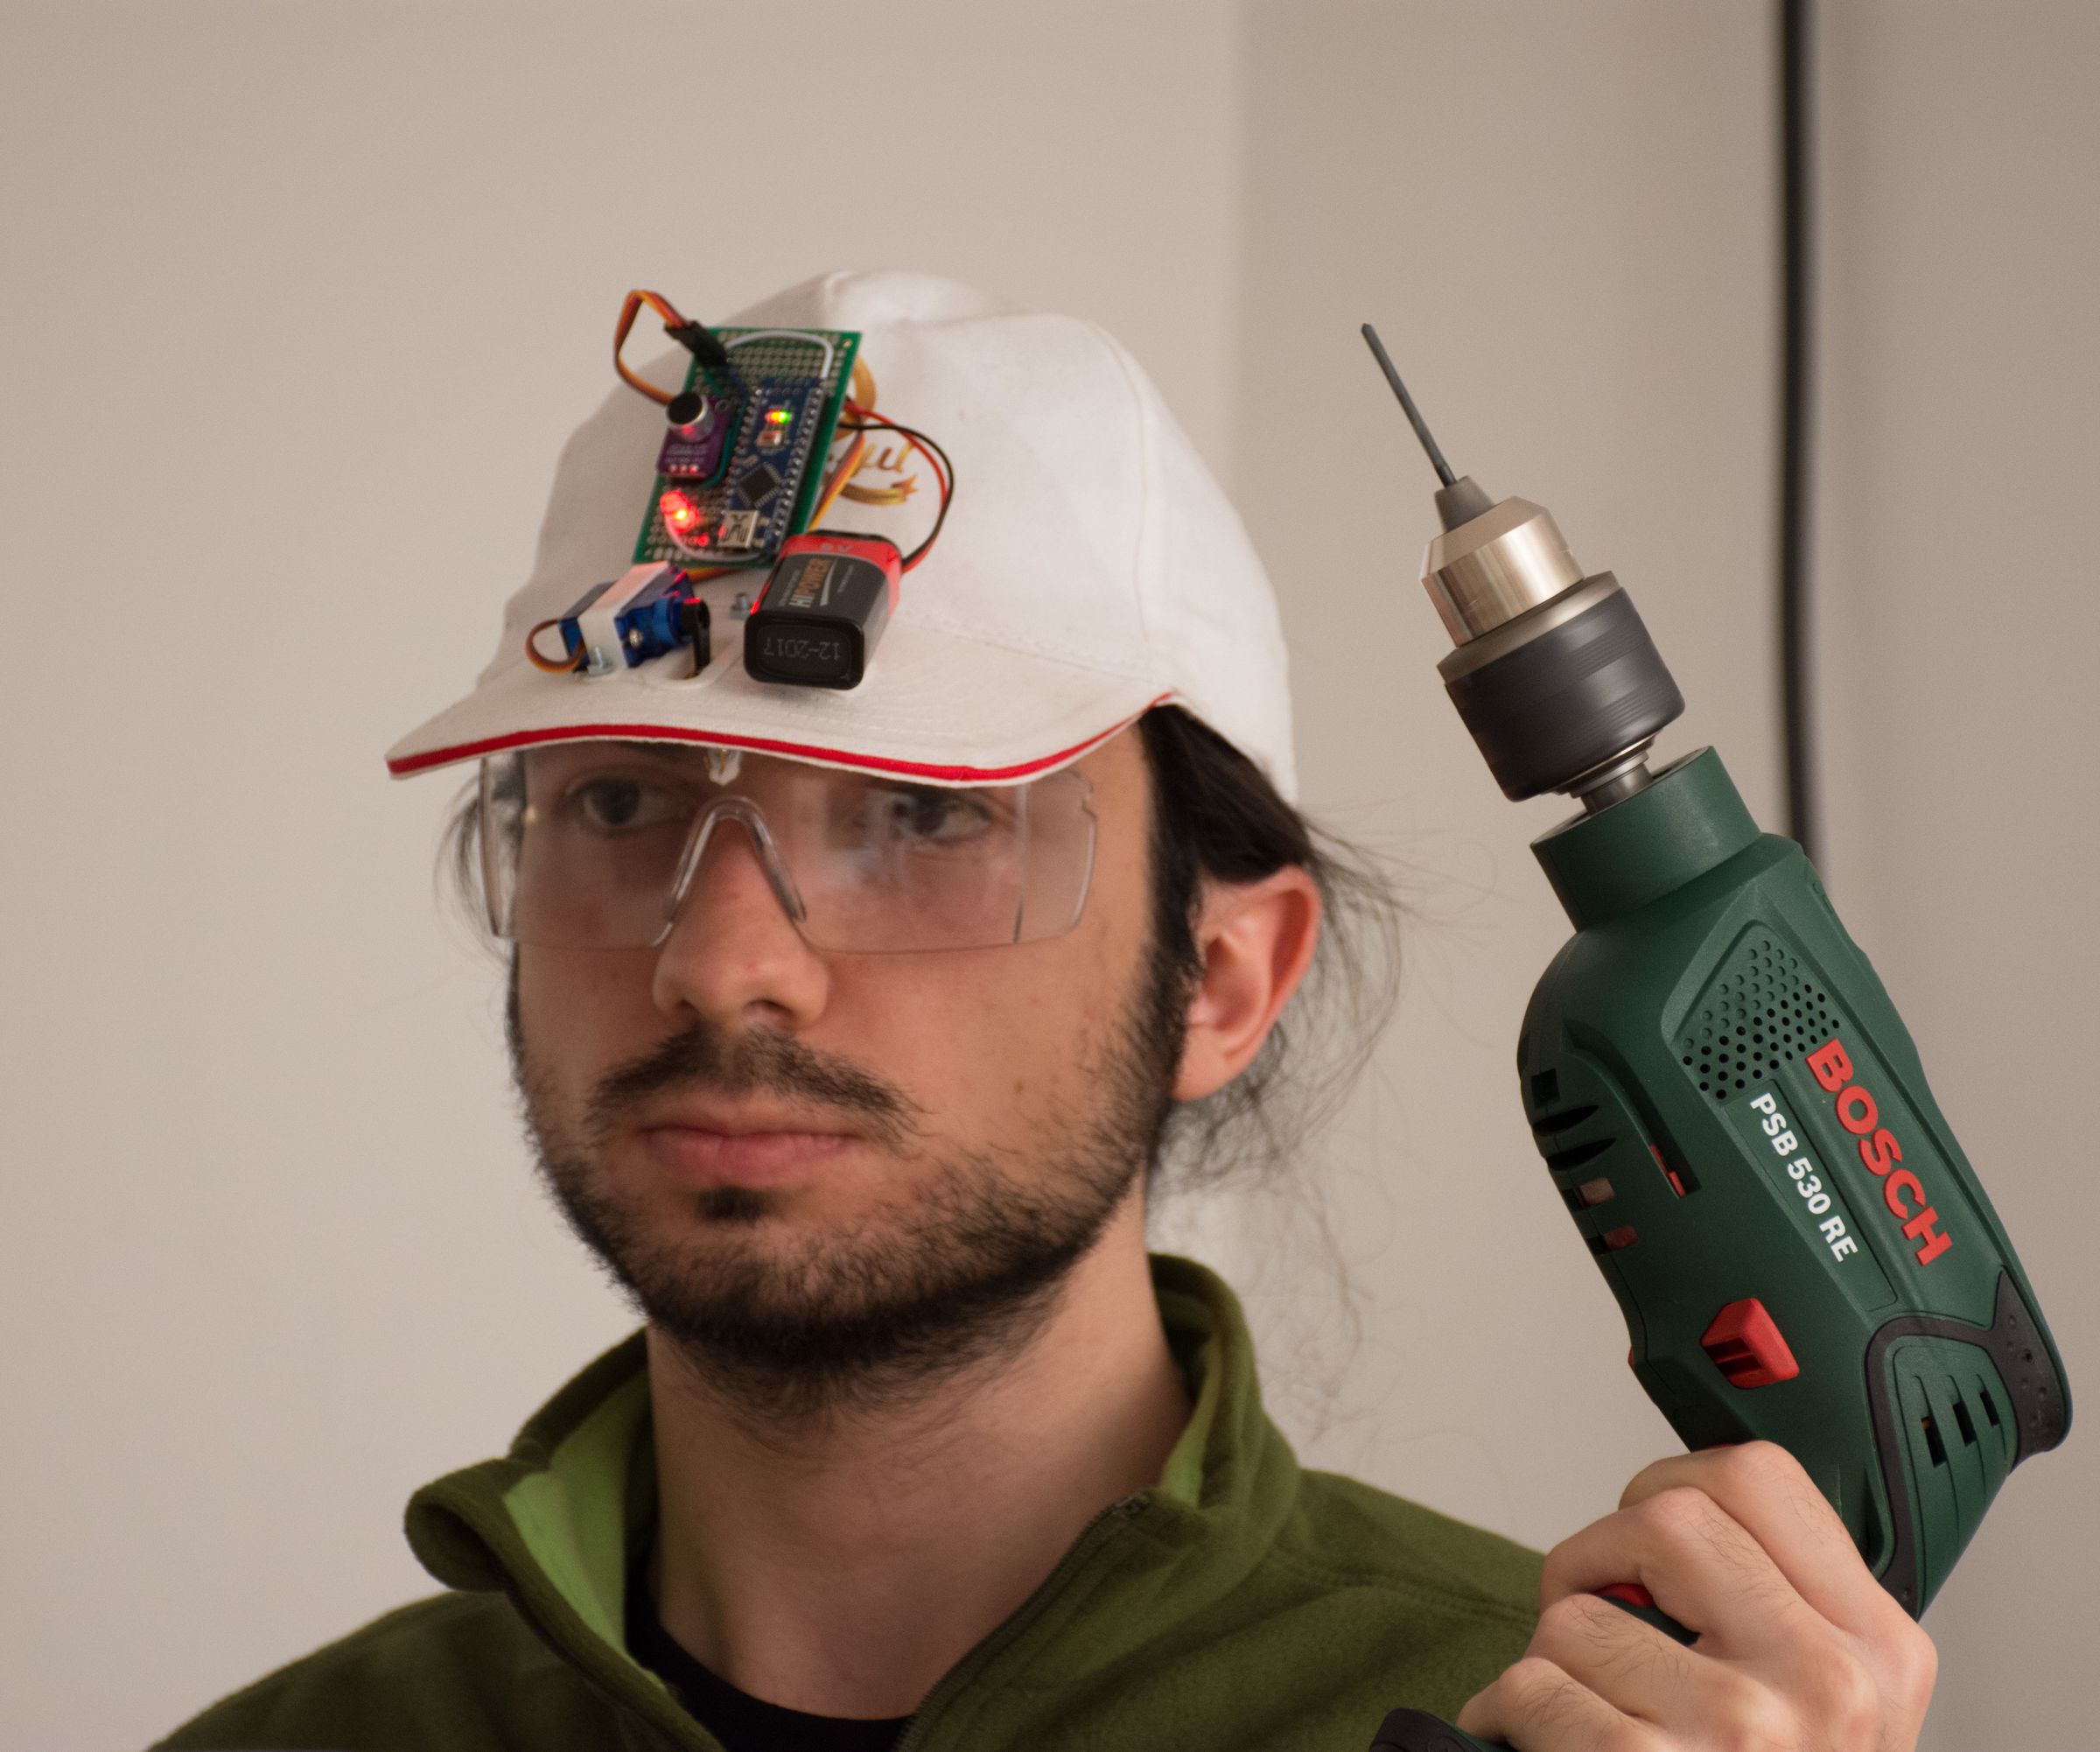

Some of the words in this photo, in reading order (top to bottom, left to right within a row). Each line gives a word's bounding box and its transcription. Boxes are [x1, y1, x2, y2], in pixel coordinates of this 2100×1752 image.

[764, 638, 840, 661] 12-2017
[1750, 1092, 1798, 1156] PSB
[1788, 1158, 1831, 1214] 530
[1819, 1216, 1858, 1262] RE
[1806, 1038, 1952, 1266] BOSCH
